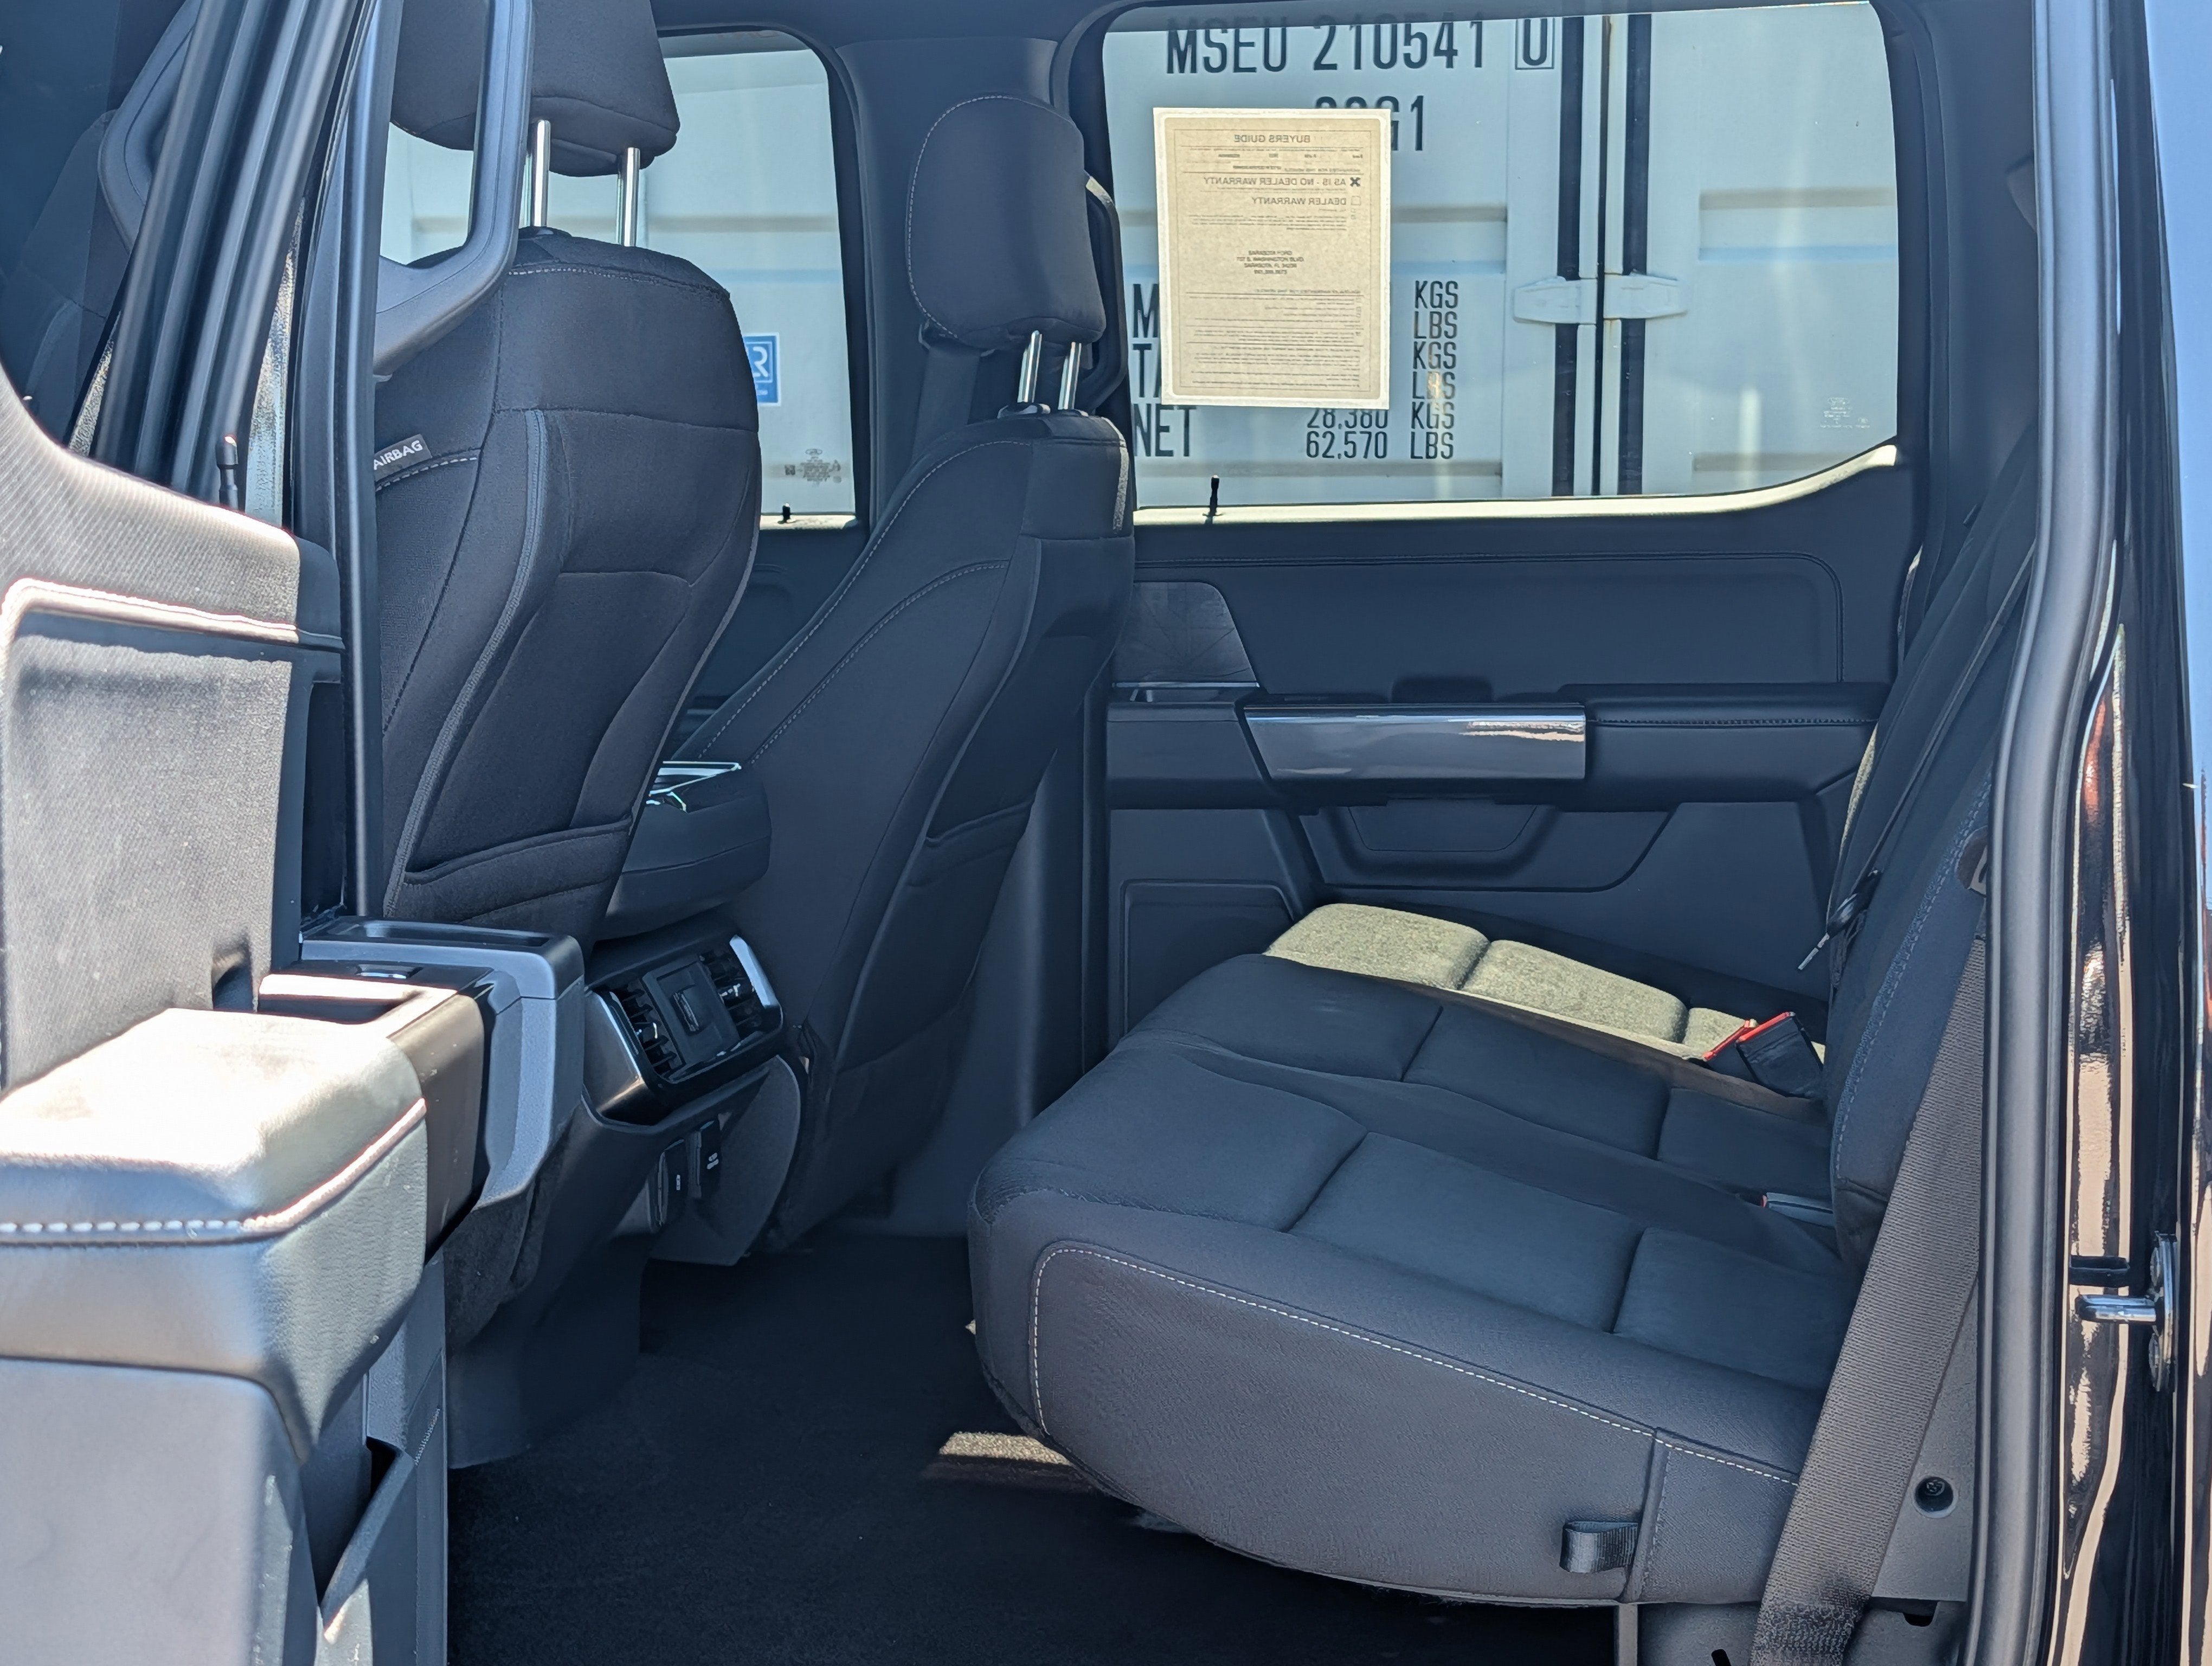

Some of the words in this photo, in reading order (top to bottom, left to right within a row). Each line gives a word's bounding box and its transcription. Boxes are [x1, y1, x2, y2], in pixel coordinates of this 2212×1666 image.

[1167, 21, 1287, 74] MSEU
[1313, 17, 1483, 70] 210541
[1414, 280, 1458, 309] KGS
[1413, 311, 1457, 339] LBS
[1412, 341, 1457, 370] KGS
[1412, 371, 1456, 400] LBS
[1133, 403, 1197, 457] NET
[1411, 401, 1455, 430] KGS
[373, 440, 423, 471] AIRBAG
[1410, 431, 1454, 459] LBS
